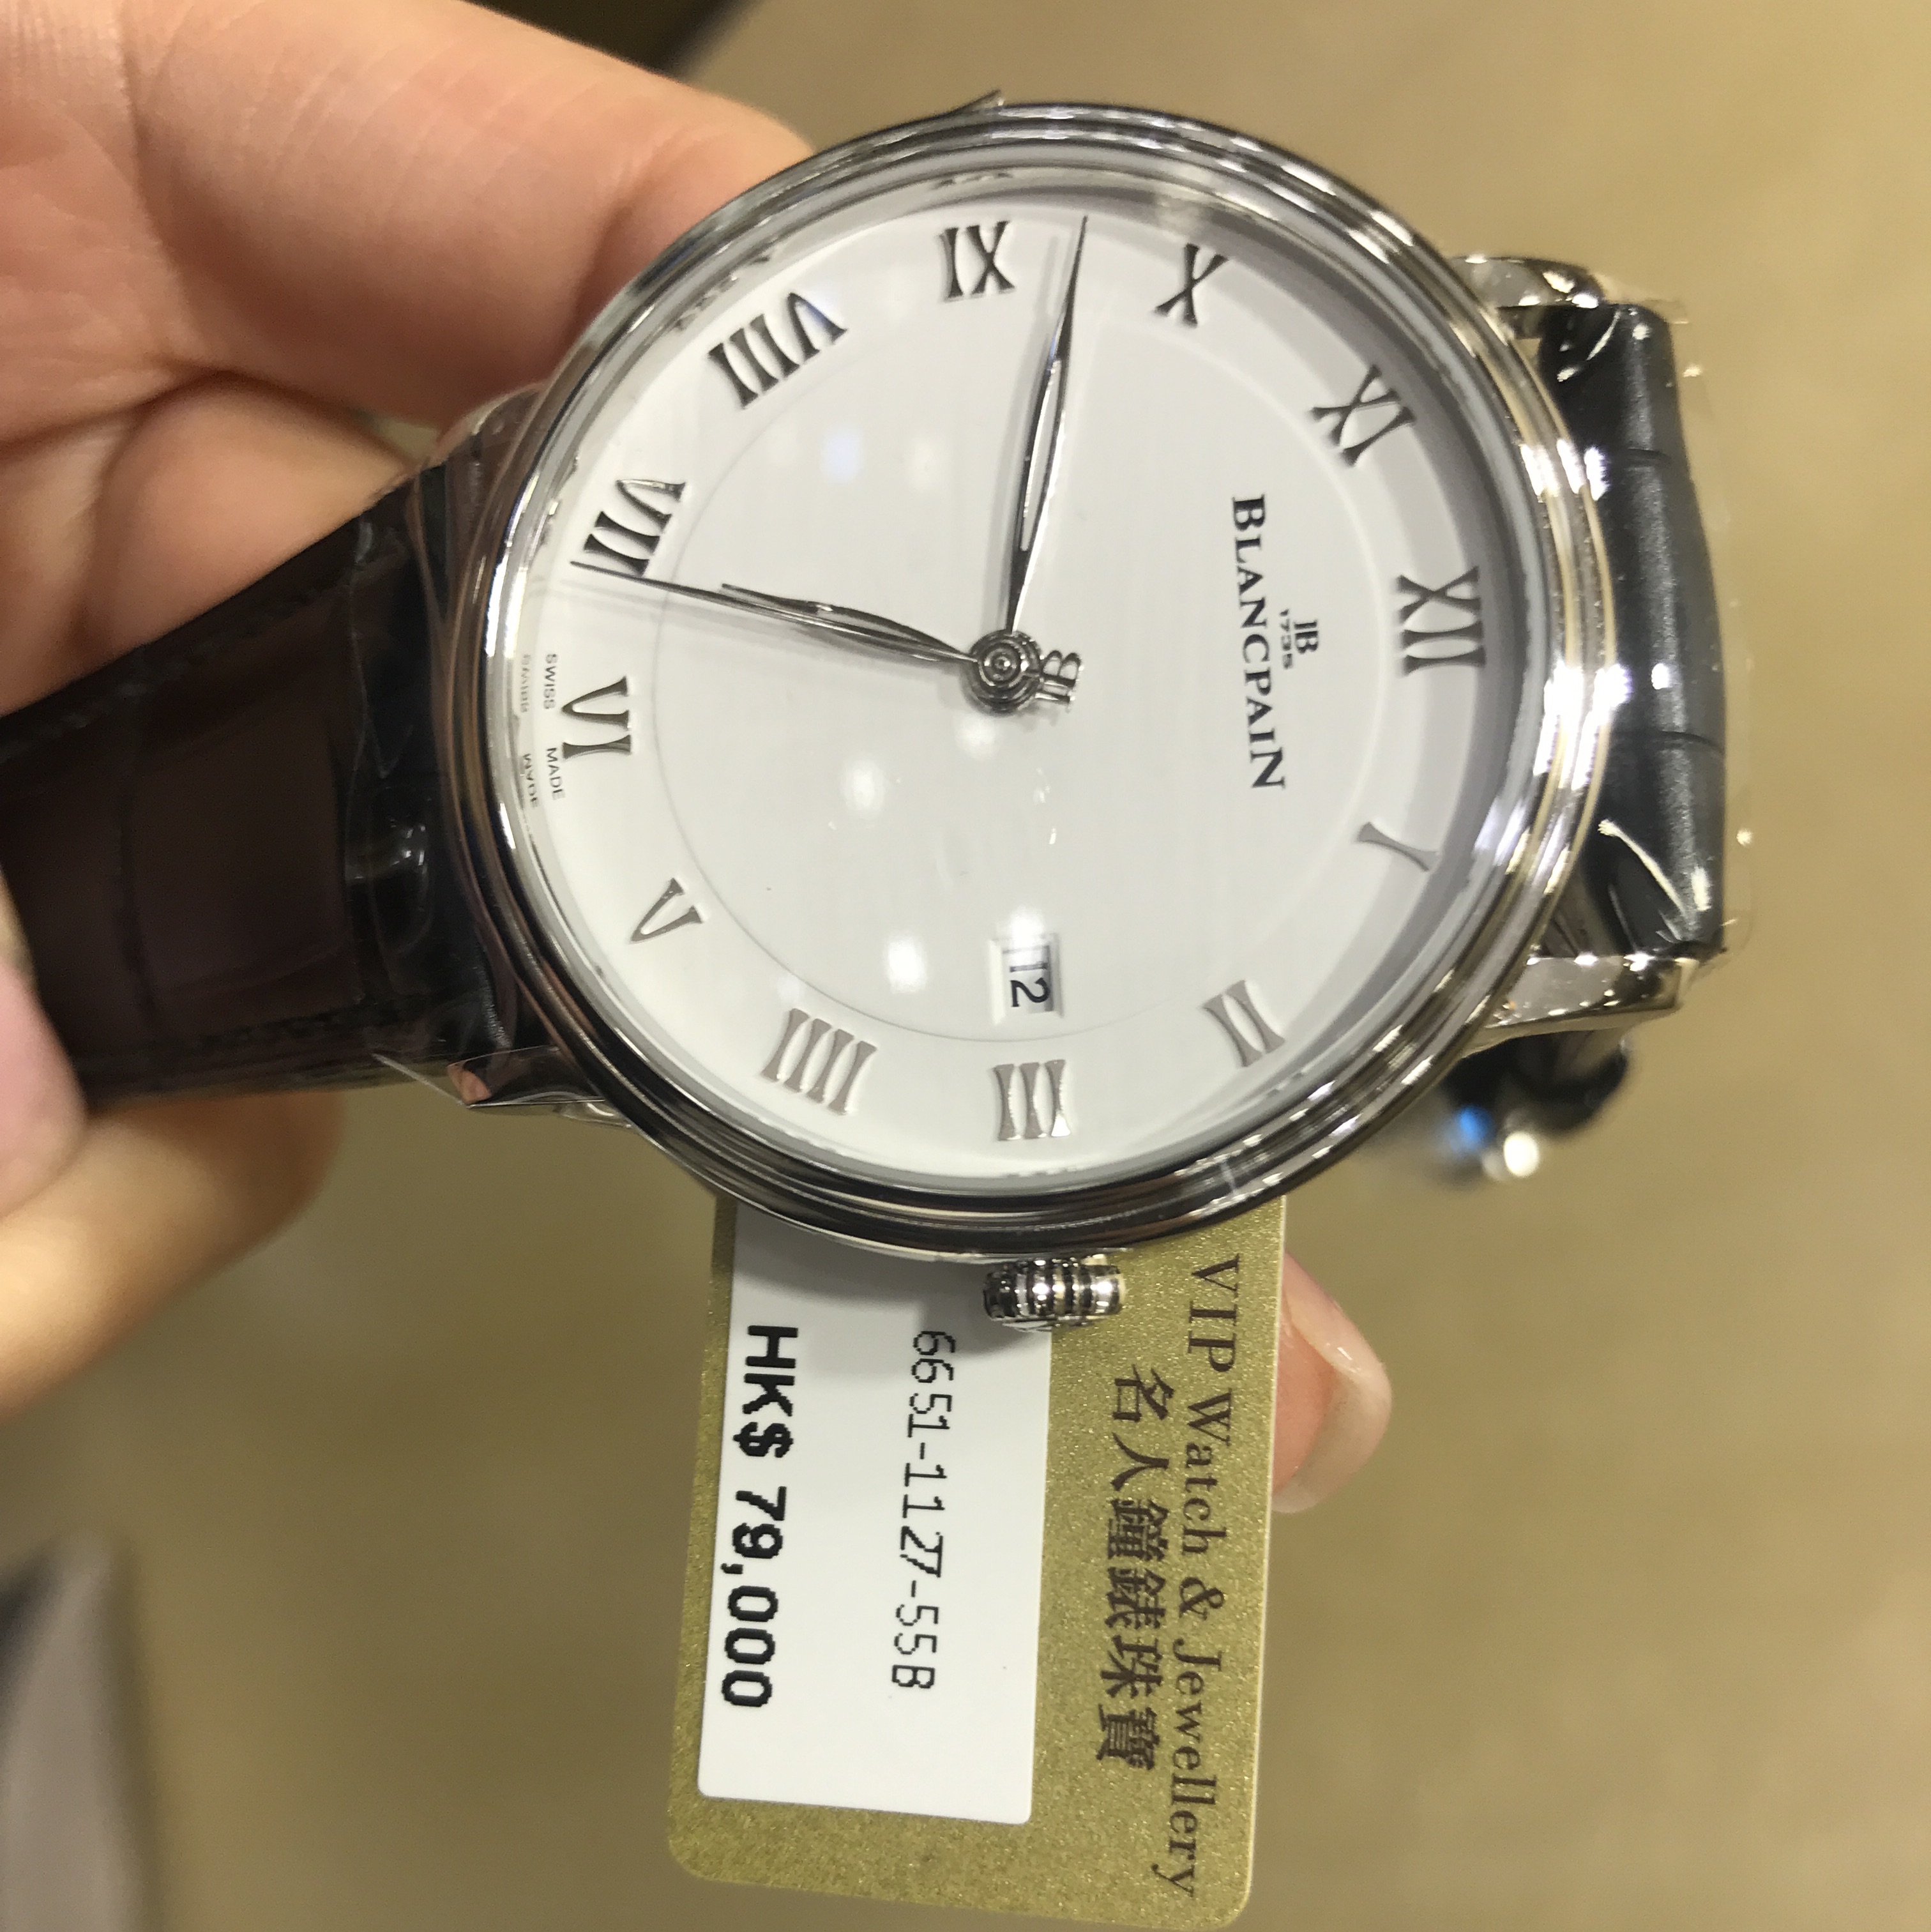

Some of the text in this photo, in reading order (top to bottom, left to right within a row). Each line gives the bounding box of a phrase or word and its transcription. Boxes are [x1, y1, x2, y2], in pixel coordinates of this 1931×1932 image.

[939, 220, 1016, 302] IX
[1152, 242, 1230, 328] X
[708, 292, 848, 409] VIII
[1309, 365, 1417, 468] XI
[1232, 494, 1287, 789] BLANCPAIN
[1397, 566, 1486, 677] XII
[544, 653, 566, 800] SWISS MADE
[562, 676, 632, 760] VI
[630, 878, 704, 944] V
[722, 1325, 798, 1708] HK$ 79,000
[892, 1329, 955, 1690] 6651-1127-55B
[1096, 1364, 1176, 1770] 名人鐘錶珠寶
[1151, 1254, 1241, 1898] VIP Watch & Jewellery
